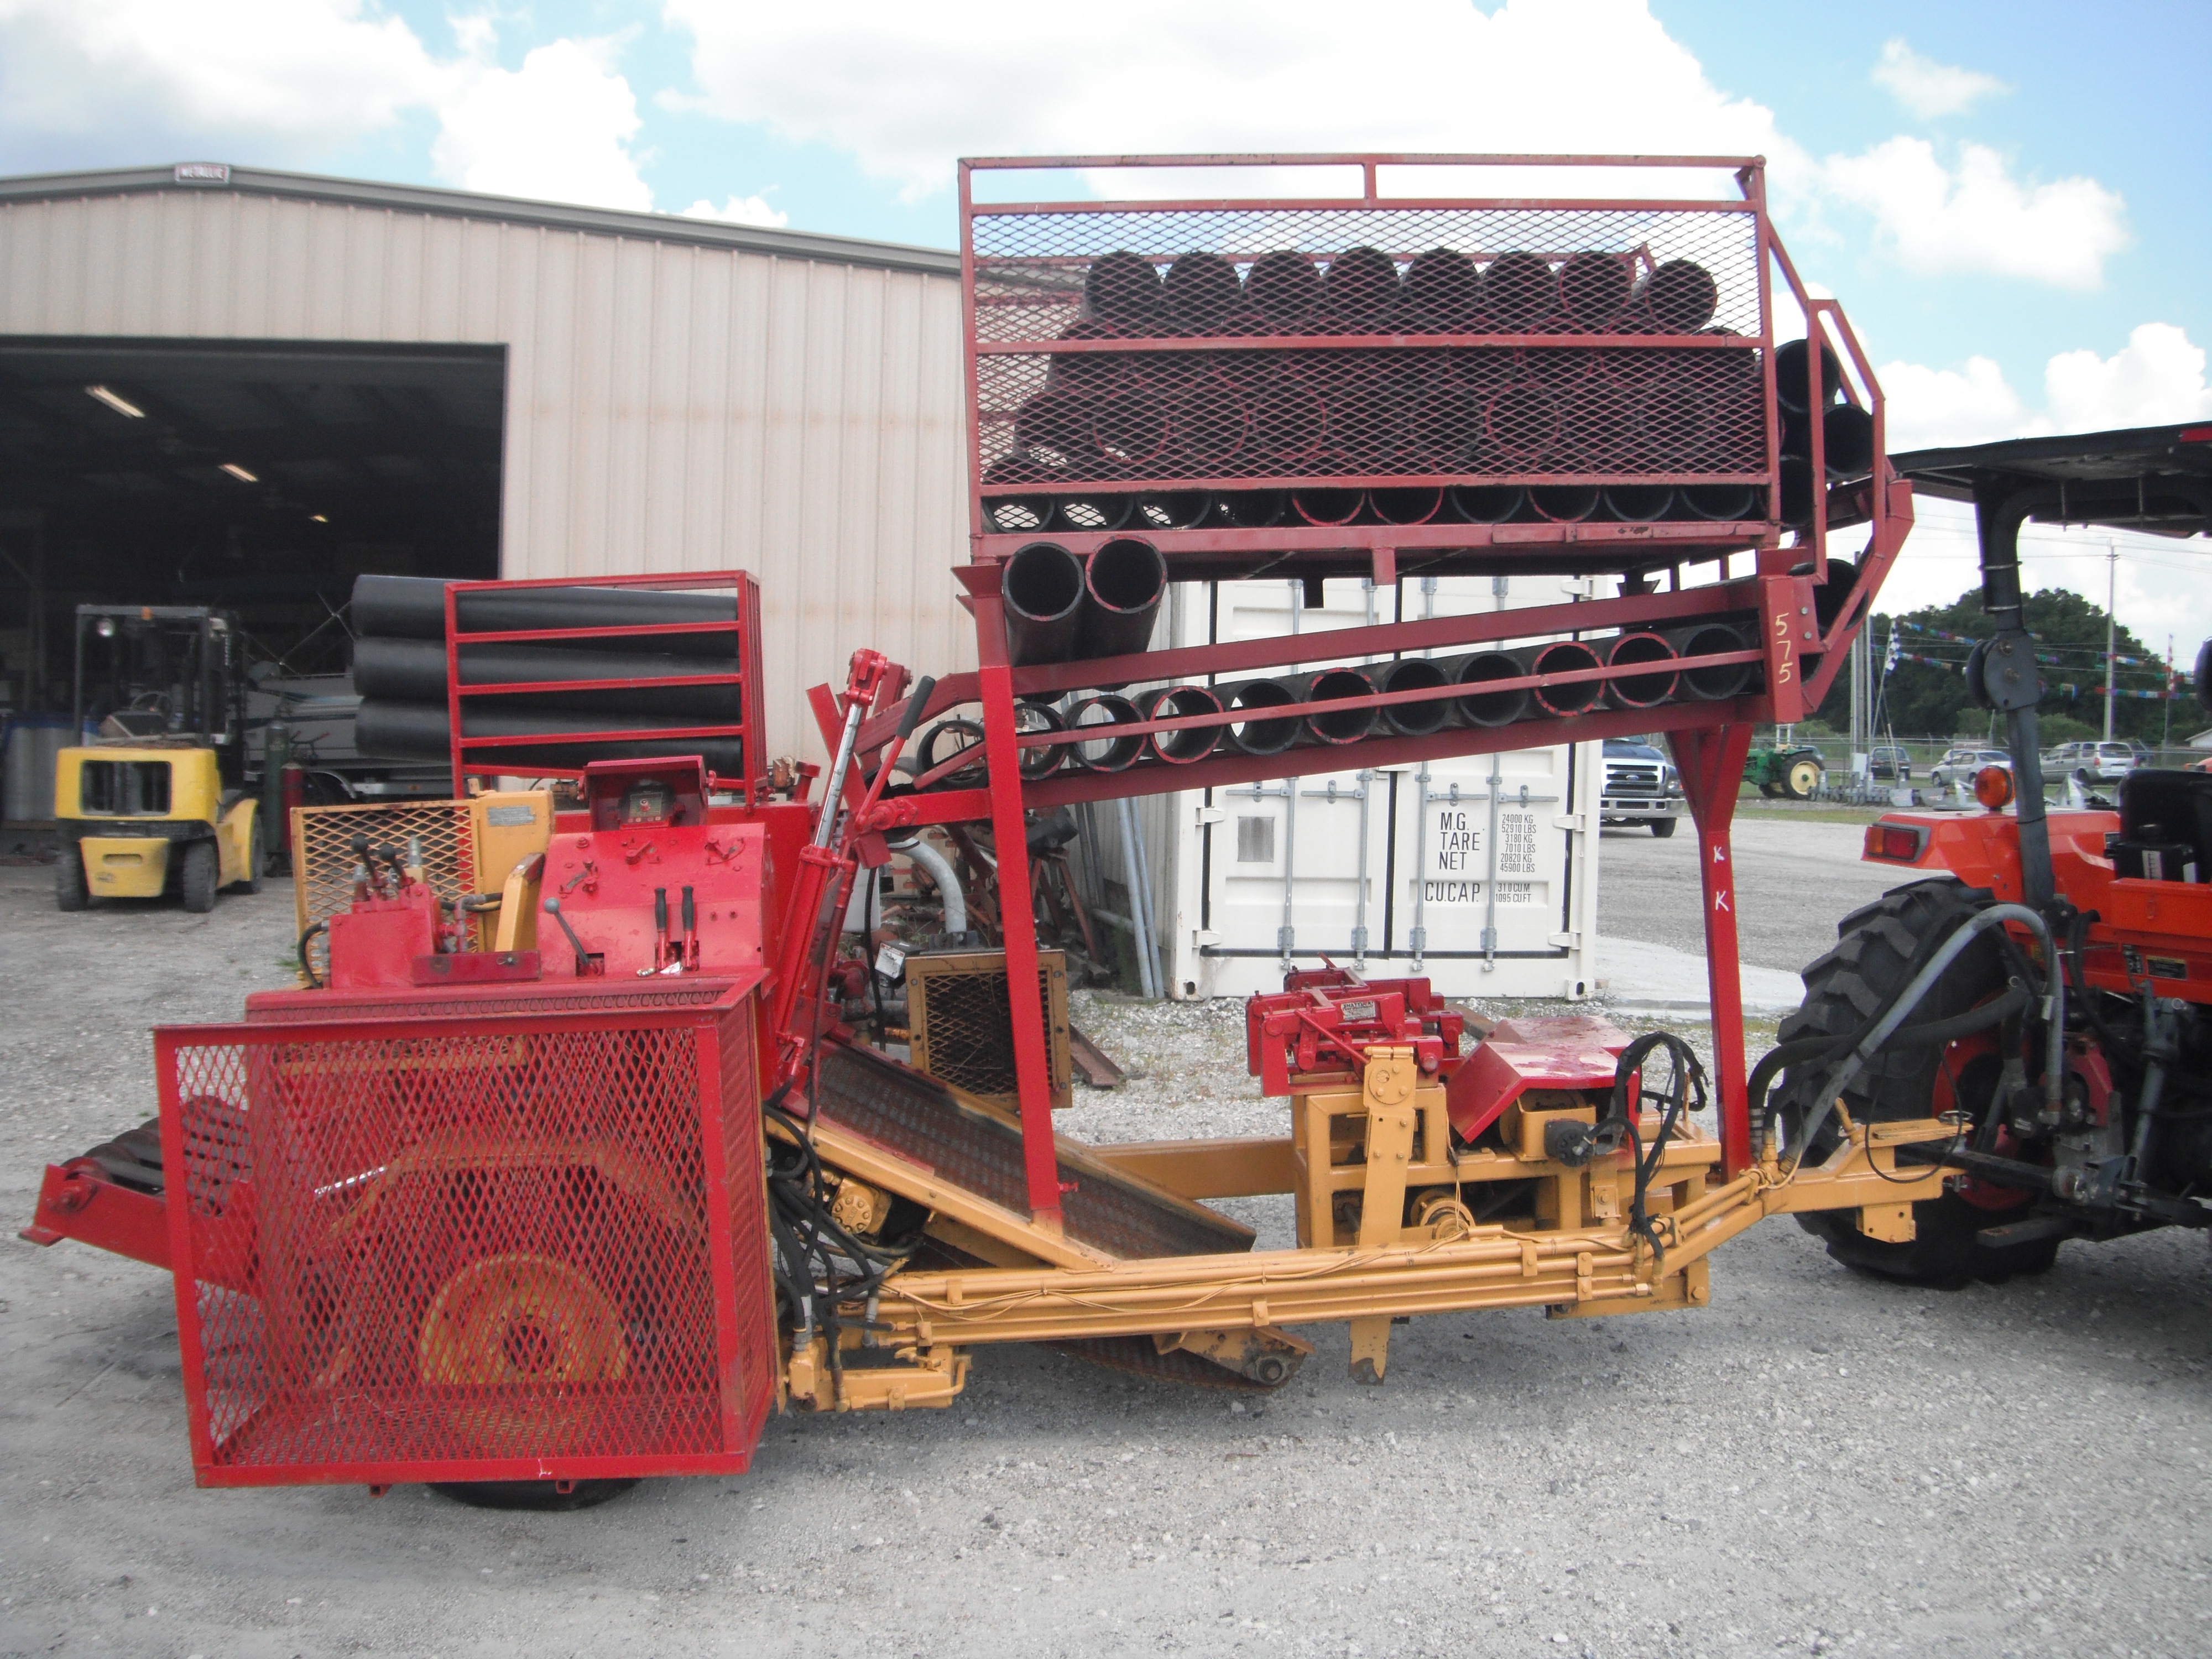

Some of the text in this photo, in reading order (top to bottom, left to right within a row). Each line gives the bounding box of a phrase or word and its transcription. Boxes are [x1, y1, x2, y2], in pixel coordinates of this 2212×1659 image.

[1502, 814, 1533, 823] 24000 KG
[1501, 823, 1536, 833] 52910 LBS
[1440, 832, 1480, 851] TARE
[1505, 834, 1532, 843] 3180 KG
[1505, 843, 1536, 853] 7010 LBS
[1439, 852, 1467, 870] NET
[1500, 853, 1532, 863] 20820 KG
[1500, 863, 1535, 873] 45900 LBS
[1495, 893, 1511, 902] 1095
[1715, 890, 1729, 911] K
